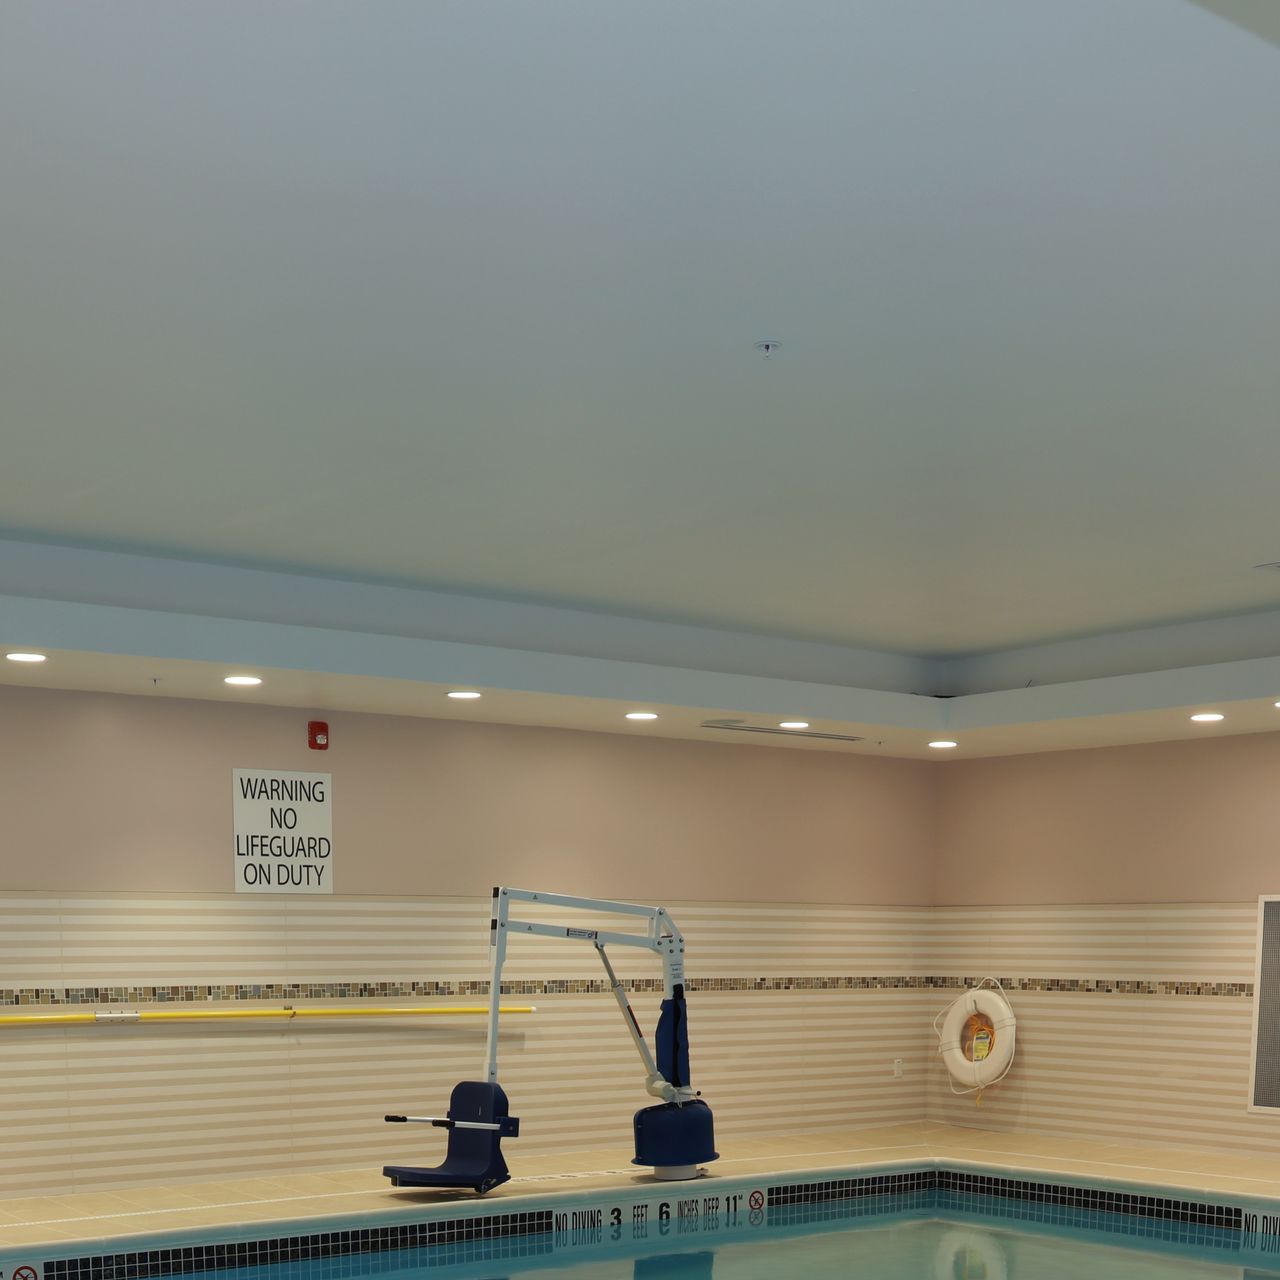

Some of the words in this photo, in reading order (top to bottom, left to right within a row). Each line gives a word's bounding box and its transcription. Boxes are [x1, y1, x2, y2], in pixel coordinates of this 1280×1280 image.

[240, 777, 325, 802] WARNING
[270, 807, 297, 830] NO
[236, 834, 331, 859] LIFEGUARD
[244, 863, 271, 885] ON
[277, 864, 325, 886] DUTY
[555, 1213, 568, 1232] NO
[572, 1209, 602, 1231] DIVING
[610, 1207, 622, 1225] 3
[633, 1204, 648, 1224] FEET
[658, 1202, 671, 1221] 6
[677, 1199, 699, 1218] INCHES
[703, 1197, 720, 1215] DEEP
[1244, 1213, 1258, 1233] NO
